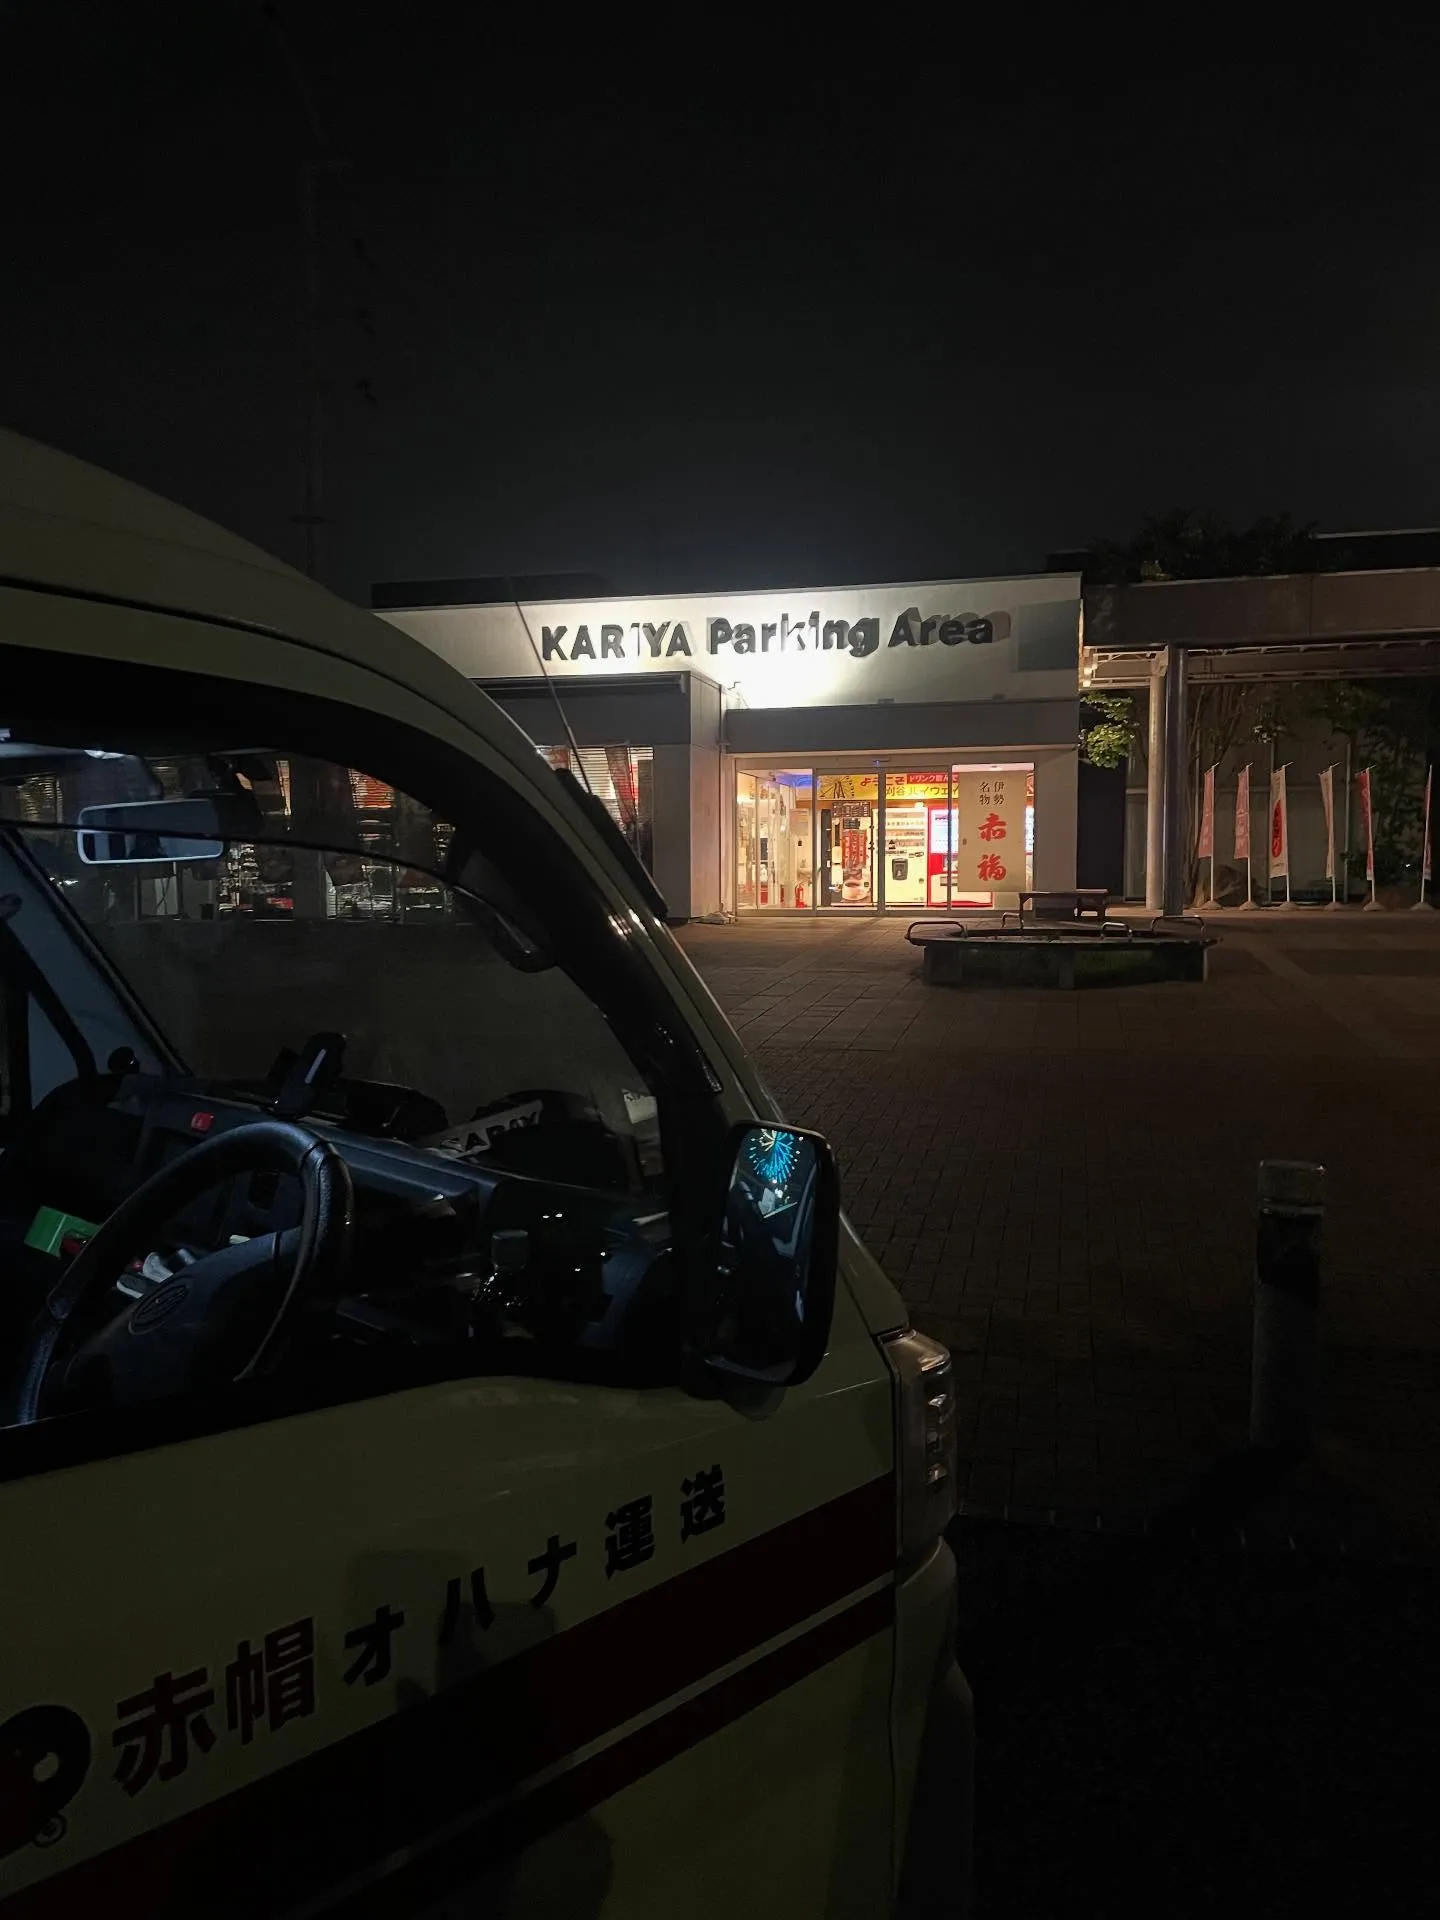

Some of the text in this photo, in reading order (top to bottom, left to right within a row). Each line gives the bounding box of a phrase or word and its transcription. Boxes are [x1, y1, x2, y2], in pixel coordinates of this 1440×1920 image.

[541, 606, 996, 662] KARIYA Parking Area
[979, 781, 991, 806] 名物
[993, 781, 1005, 805] 伊勢
[978, 813, 1007, 882] 赤福
[112, 1463, 726, 1797] 赤帽 オハナ運送
